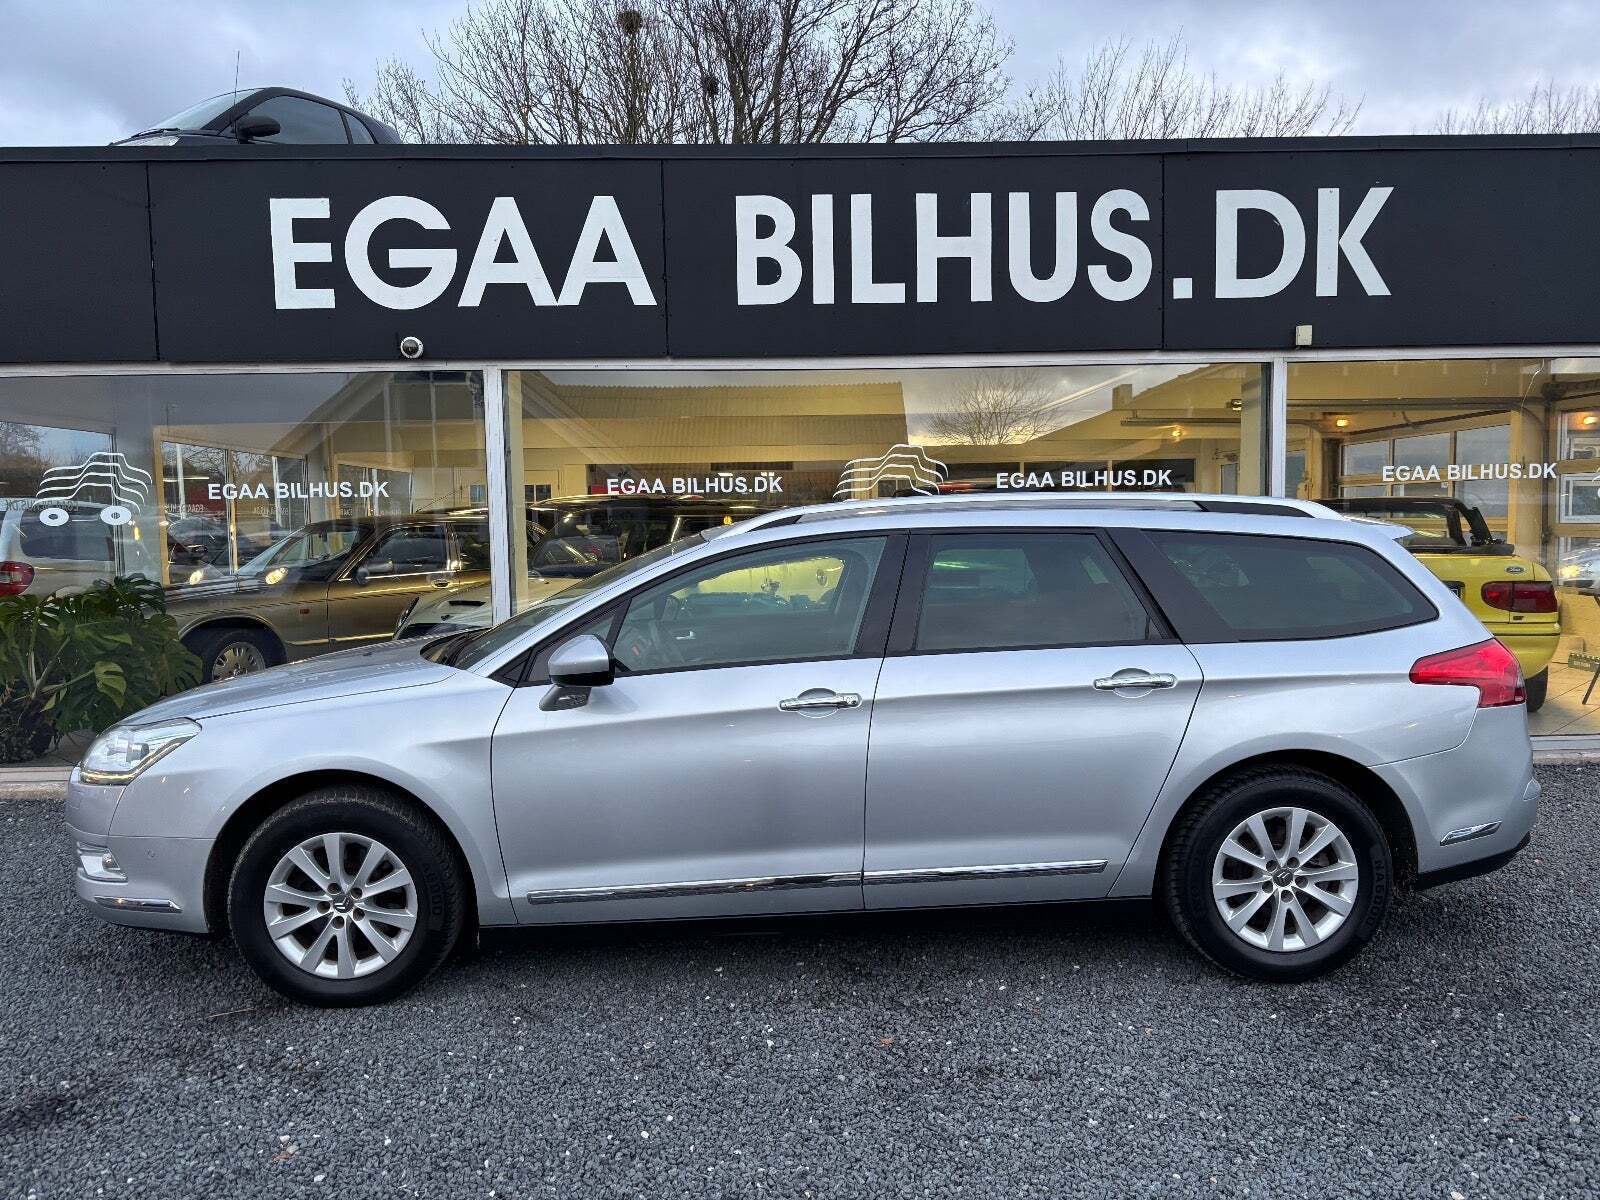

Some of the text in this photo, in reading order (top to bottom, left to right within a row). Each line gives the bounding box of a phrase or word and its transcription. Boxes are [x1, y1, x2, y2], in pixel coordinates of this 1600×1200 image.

[269, 186, 1395, 310] EGAA BILHUS.DK
[996, 469, 1173, 489] EGAA BILHUS.DK
[1382, 462, 1557, 482] EGAA BILHUS.DK
[207, 481, 390, 501] EGAA BILHUS.DK
[606, 476, 784, 495] EGAA BILHUS.DK
